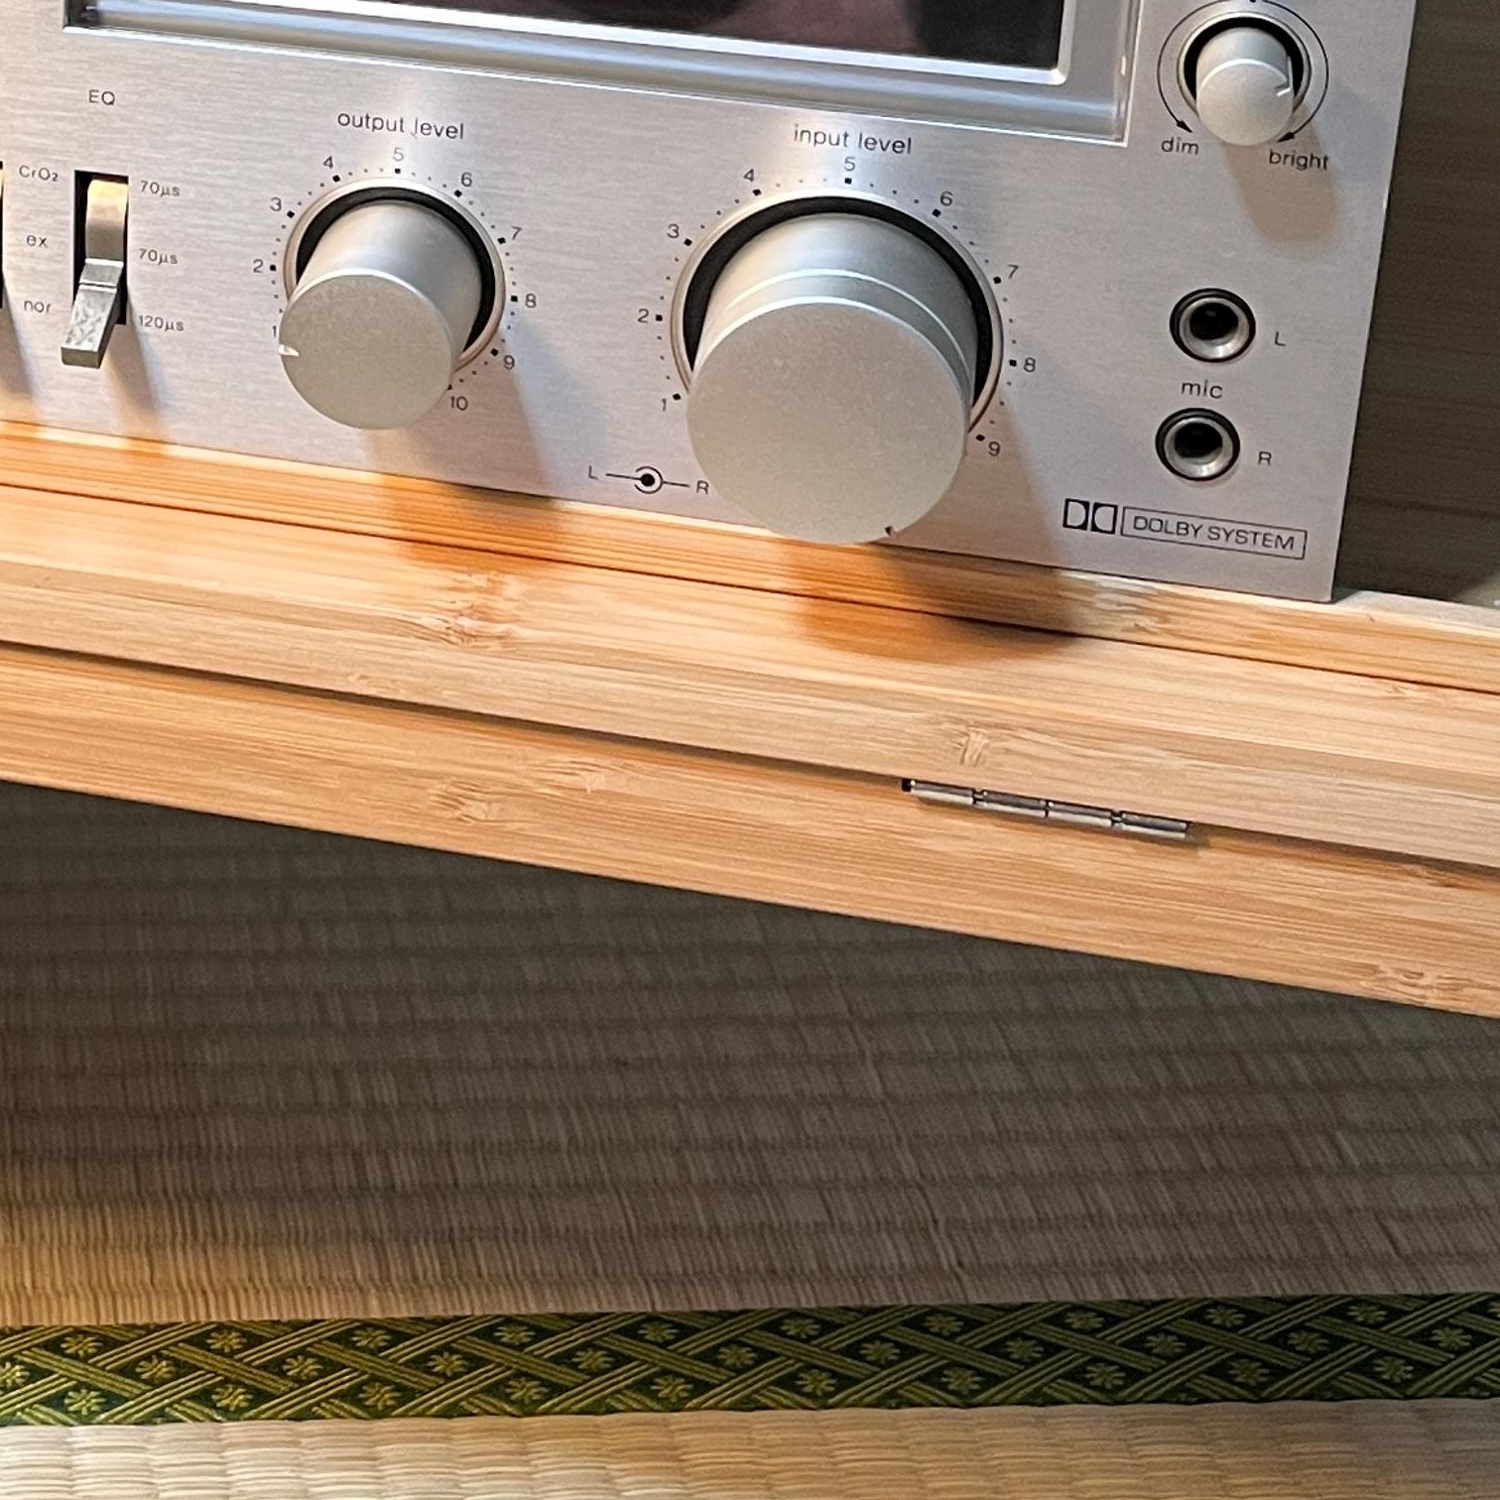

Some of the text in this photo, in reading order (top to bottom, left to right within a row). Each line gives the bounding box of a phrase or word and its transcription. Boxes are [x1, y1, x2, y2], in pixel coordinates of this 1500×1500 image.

[88, 90, 116, 107] EQ
[337, 112, 464, 140] output level
[793, 124, 912, 155] input level
[1161, 136, 1199, 155] dim
[323, 155, 334, 169] 4
[393, 148, 404, 161] 5
[1269, 149, 1329, 171] bright
[843, 157, 856, 171] 5
[461, 172, 473, 187] 6
[744, 168, 755, 183] 4
[269, 197, 282, 211] 3
[940, 191, 953, 206] 6
[511, 226, 522, 240] 7
[667, 224, 679, 239] 3
[26, 235, 48, 248] ex
[253, 259, 264, 273] 2
[1006, 265, 1020, 280] 7
[23, 300, 52, 314] nor
[525, 294, 536, 308] 8
[637, 309, 650, 324] 2
[1274, 331, 1286, 346] L
[504, 355, 515, 369] 9
[1023, 358, 1036, 373] 8
[1181, 380, 1223, 399] mic
[450, 397, 469, 411] 10
[988, 441, 1000, 456] 9
[1258, 451, 1272, 466] R
[589, 466, 599, 480] L
[696, 480, 710, 495] R
[1133, 515, 1295, 549] DOLBY SYSTEM
